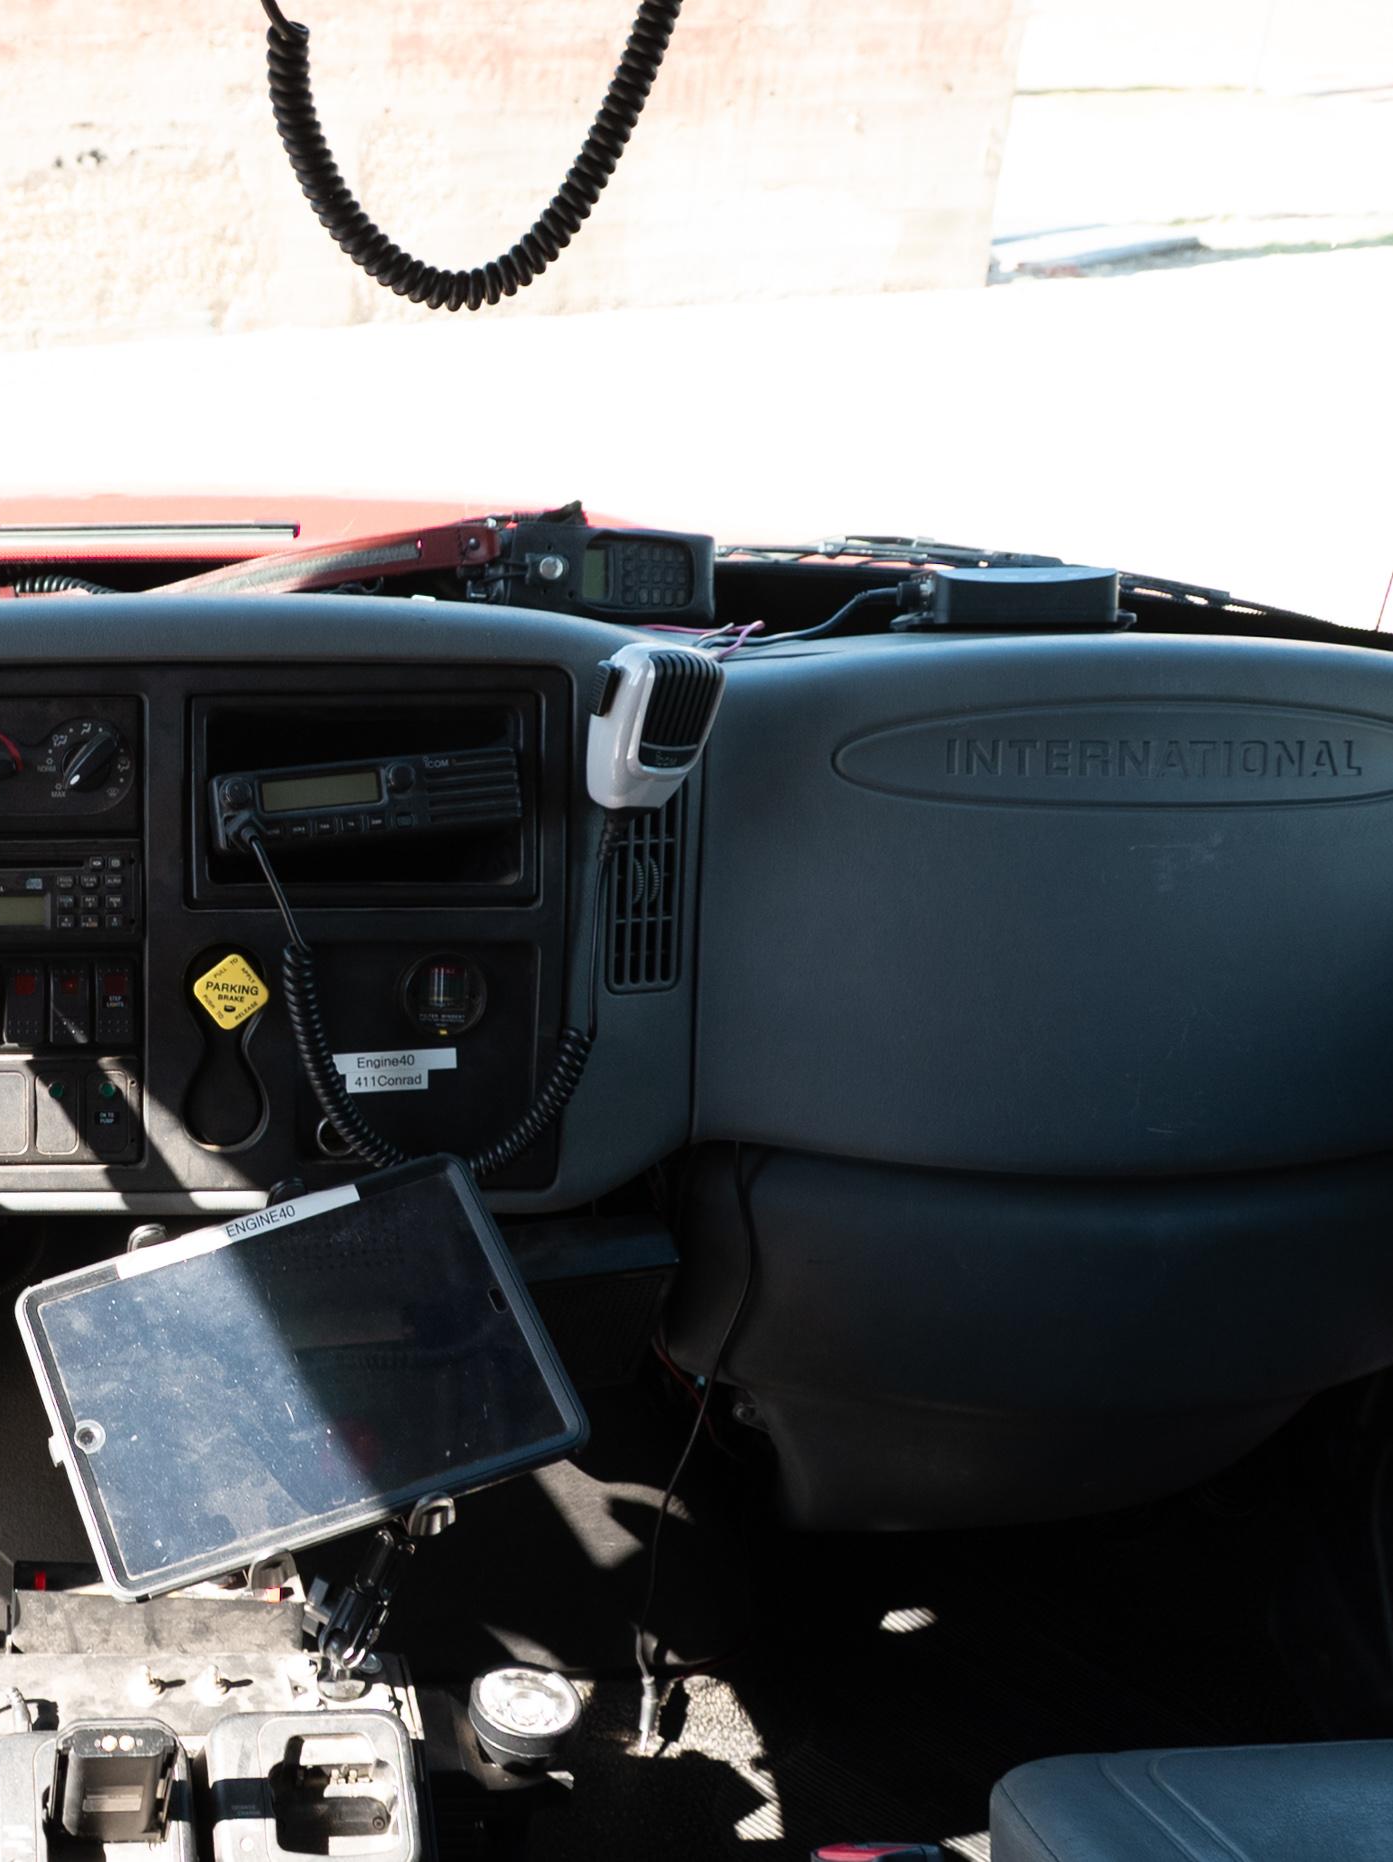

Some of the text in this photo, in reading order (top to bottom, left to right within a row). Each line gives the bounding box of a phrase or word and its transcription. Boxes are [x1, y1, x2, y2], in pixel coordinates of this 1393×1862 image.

[947, 738, 1363, 777] INTERNATIONAL
[205, 981, 259, 997] PARKING
[217, 994, 245, 1003] BRAKE
[235, 1001, 258, 1020] RELEASE
[357, 1055, 415, 1070] Engine40
[354, 1074, 422, 1088] 411Conrad
[225, 1204, 296, 1238] ENGINE40
